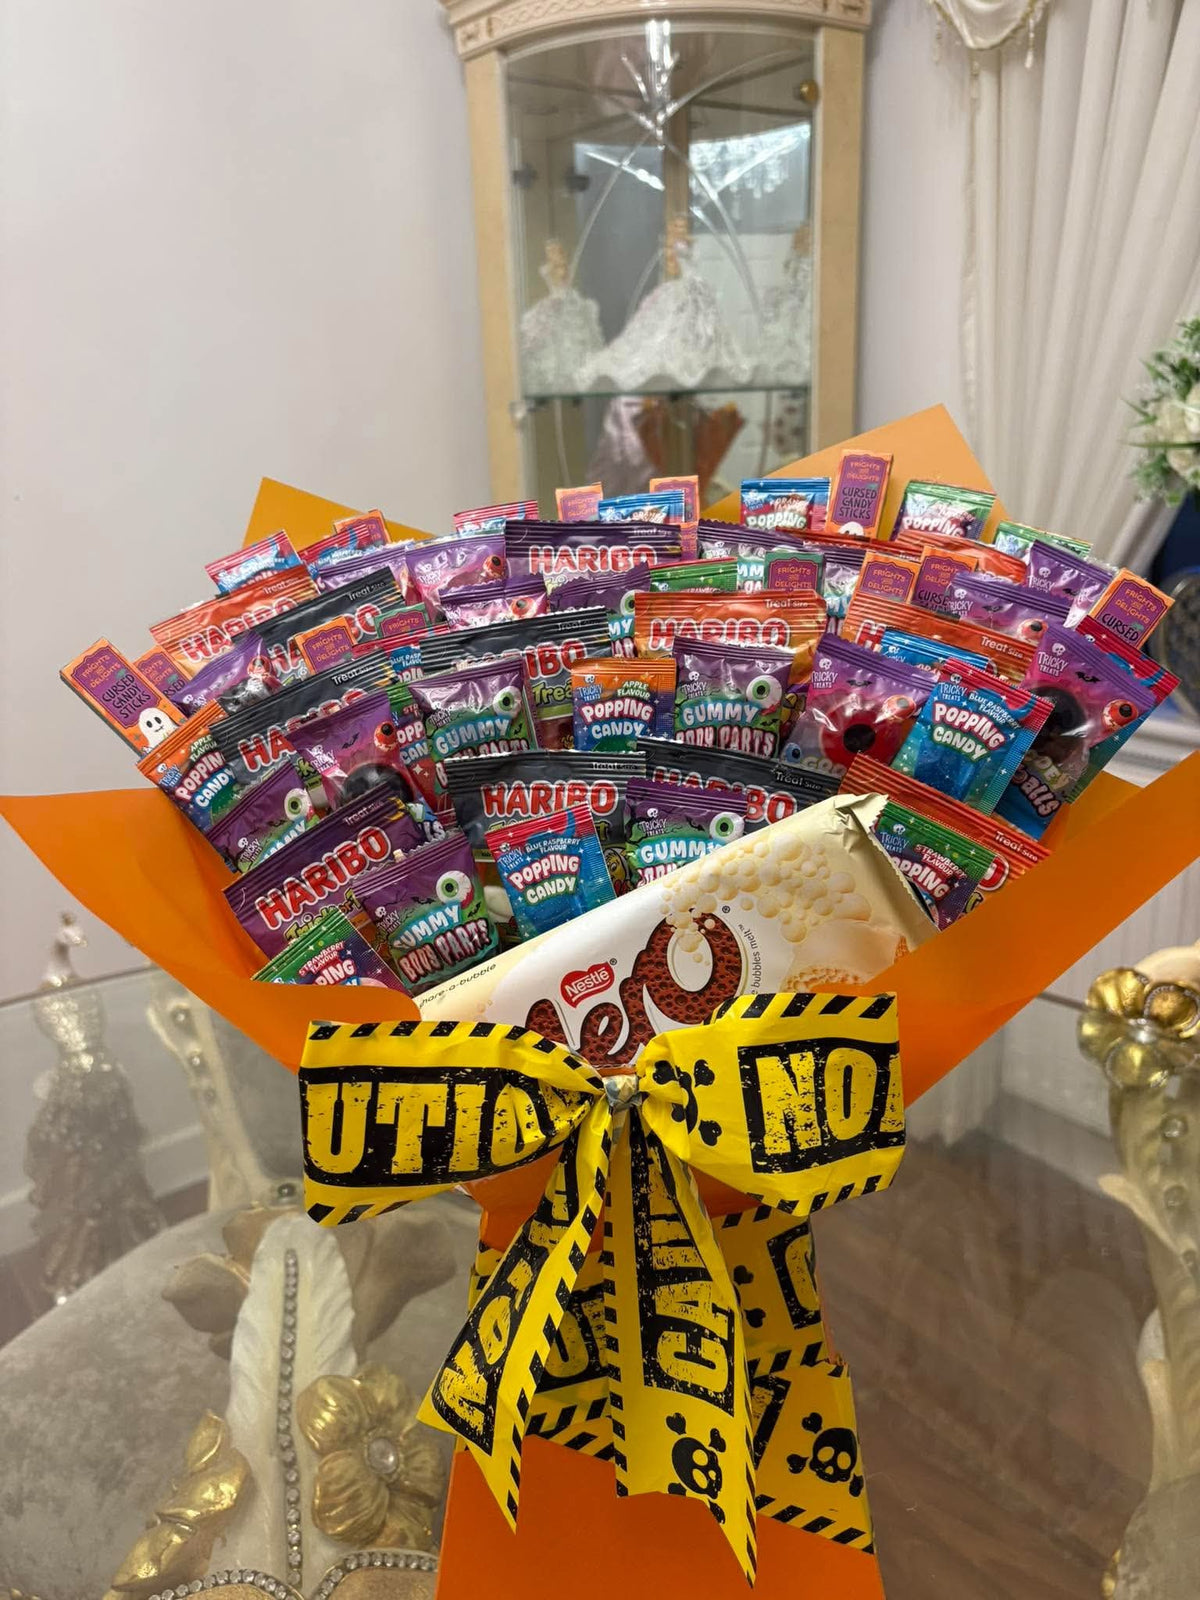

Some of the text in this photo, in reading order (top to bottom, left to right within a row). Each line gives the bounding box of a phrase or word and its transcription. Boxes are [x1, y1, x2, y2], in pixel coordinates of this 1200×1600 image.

[842, 486, 878, 500] CURSED
[842, 498, 874, 511] CANDY
[746, 511, 808, 530] POPPING
[838, 507, 872, 520] STICKS
[903, 516, 966, 538] POPPING
[528, 545, 657, 575] HARIBO
[924, 574, 951, 587] DELIGH
[1124, 588, 1158, 613] FRIGHTS
[178, 597, 299, 664] HARIBO
[649, 617, 791, 651] HARIBO
[1101, 613, 1139, 642] CURSED
[981, 635, 1010, 653] Treat
[1037, 651, 1068, 672] TRICKY
[1039, 664, 1060, 677] TREATS
[101, 673, 136, 703] CURSED
[165, 678, 186, 699] RSED
[331, 668, 359, 686] Treat
[623, 680, 649, 690] APPLE
[681, 681, 708, 696] TRICKY
[811, 670, 839, 684] TRICKY
[111, 684, 143, 714] CANDY
[533, 681, 573, 706] Trea
[577, 684, 603, 699] TRICKY
[617, 688, 652, 701] FLAVOUR
[939, 682, 968, 698] TRICKY
[118, 690, 151, 720] STICKS
[581, 698, 654, 725] POPPING
[683, 702, 761, 727] GUMMY
[968, 692, 1022, 730] BLUE RASPBERRY
[979, 704, 1007, 725] FLAVOUR
[435, 718, 510, 756] GUMMY
[591, 721, 646, 740] CANDY
[934, 703, 1006, 749] POPPING
[189, 734, 213, 752] APPLE
[718, 725, 776, 762] PARTS
[932, 726, 989, 761] CANDY
[175, 751, 226, 801] POPPIN
[194, 767, 235, 808] CANDY
[775, 771, 804, 787] Treat
[481, 779, 619, 818] HARIBO
[345, 806, 369, 826] Treat
[637, 818, 667, 833] TRICKY
[525, 837, 581, 854] BLUE RASPBERRY
[539, 843, 568, 853] FLAVOUR
[880, 830, 910, 850] TRICKY
[994, 831, 1024, 852] Treat
[500, 846, 523, 868] TRICKY
[915, 844, 968, 880] STRAWBERRY
[922, 852, 955, 877] FLAVOUR
[254, 825, 392, 931] HARIBO
[508, 853, 580, 891] POPPING
[893, 857, 951, 898] OPPING
[526, 875, 577, 904] CANDY
[392, 904, 460, 950] GUMMY
[298, 939, 346, 978] STRAWBERRY
[309, 949, 339, 974] FLAVOUR
[400, 918, 490, 983] BODY PARTS
[315, 958, 356, 986] PING
[750, 951, 763, 989] bubbles
